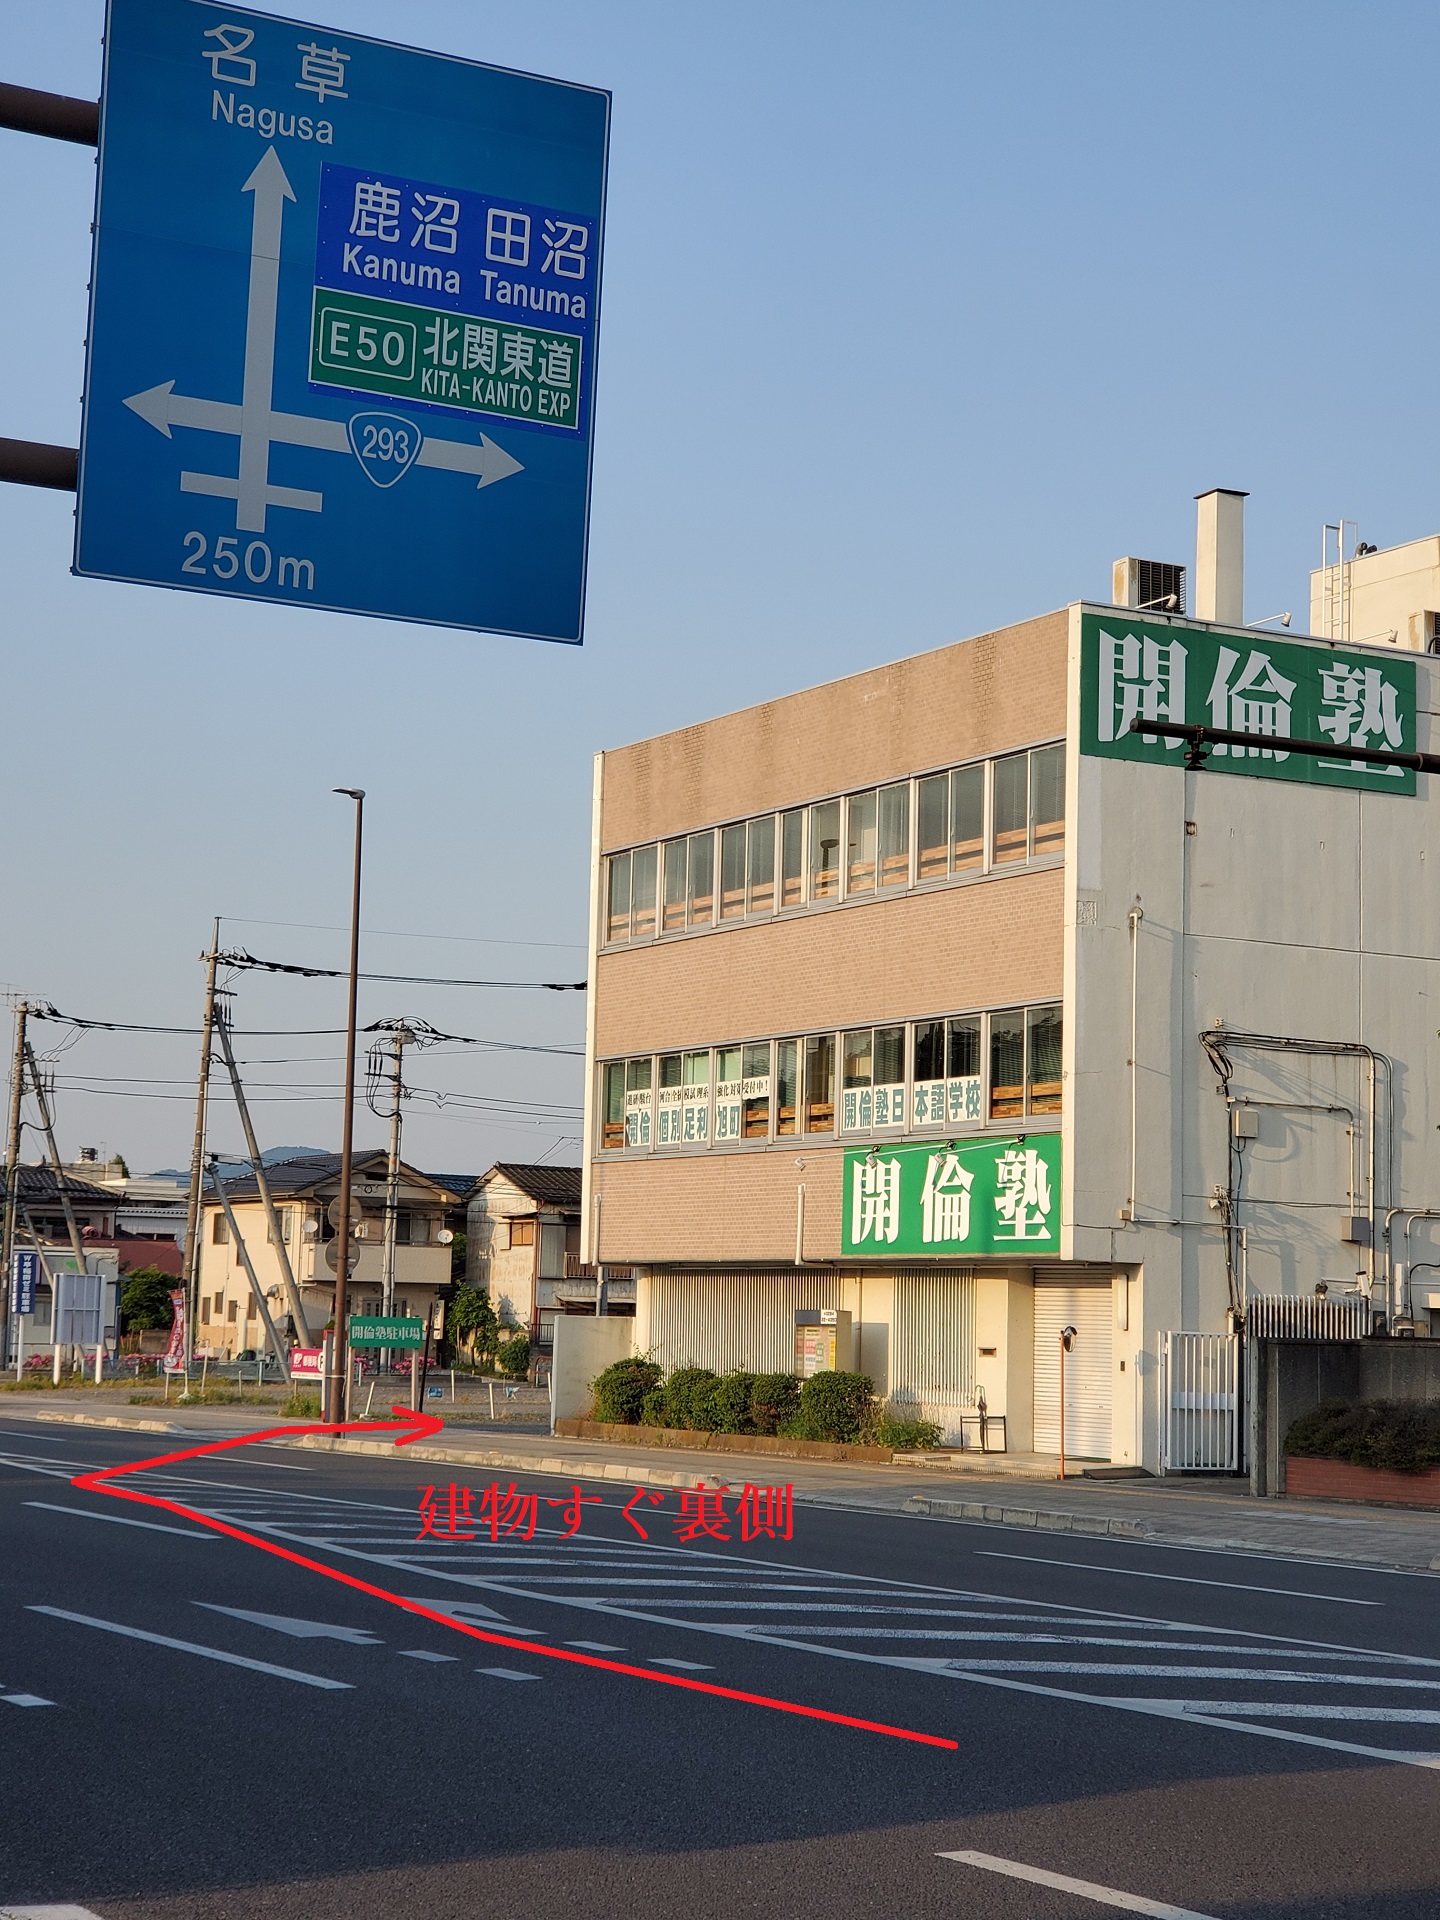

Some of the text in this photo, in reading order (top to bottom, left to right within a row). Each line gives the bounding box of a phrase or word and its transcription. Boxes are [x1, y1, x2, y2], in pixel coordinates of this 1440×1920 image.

[202, 23, 352, 104] 名草
[211, 90, 334, 145] Nagusa
[349, 180, 590, 281] 鹿沼 田沼
[342, 242, 587, 319] Kanuma Tanuma
[328, 328, 406, 368] E50
[422, 317, 574, 390] 北関東道
[420, 370, 571, 419] KITA-KANTO EXP
[361, 423, 410, 465] 293
[181, 530, 316, 591] 250m
[1098, 629, 1406, 778] 開倫塾
[844, 1079, 981, 1130] 開倫塾日本語学校
[850, 1148, 1054, 1245] 開倫塾
[351, 1325, 421, 1341] 開倫塾駐車場
